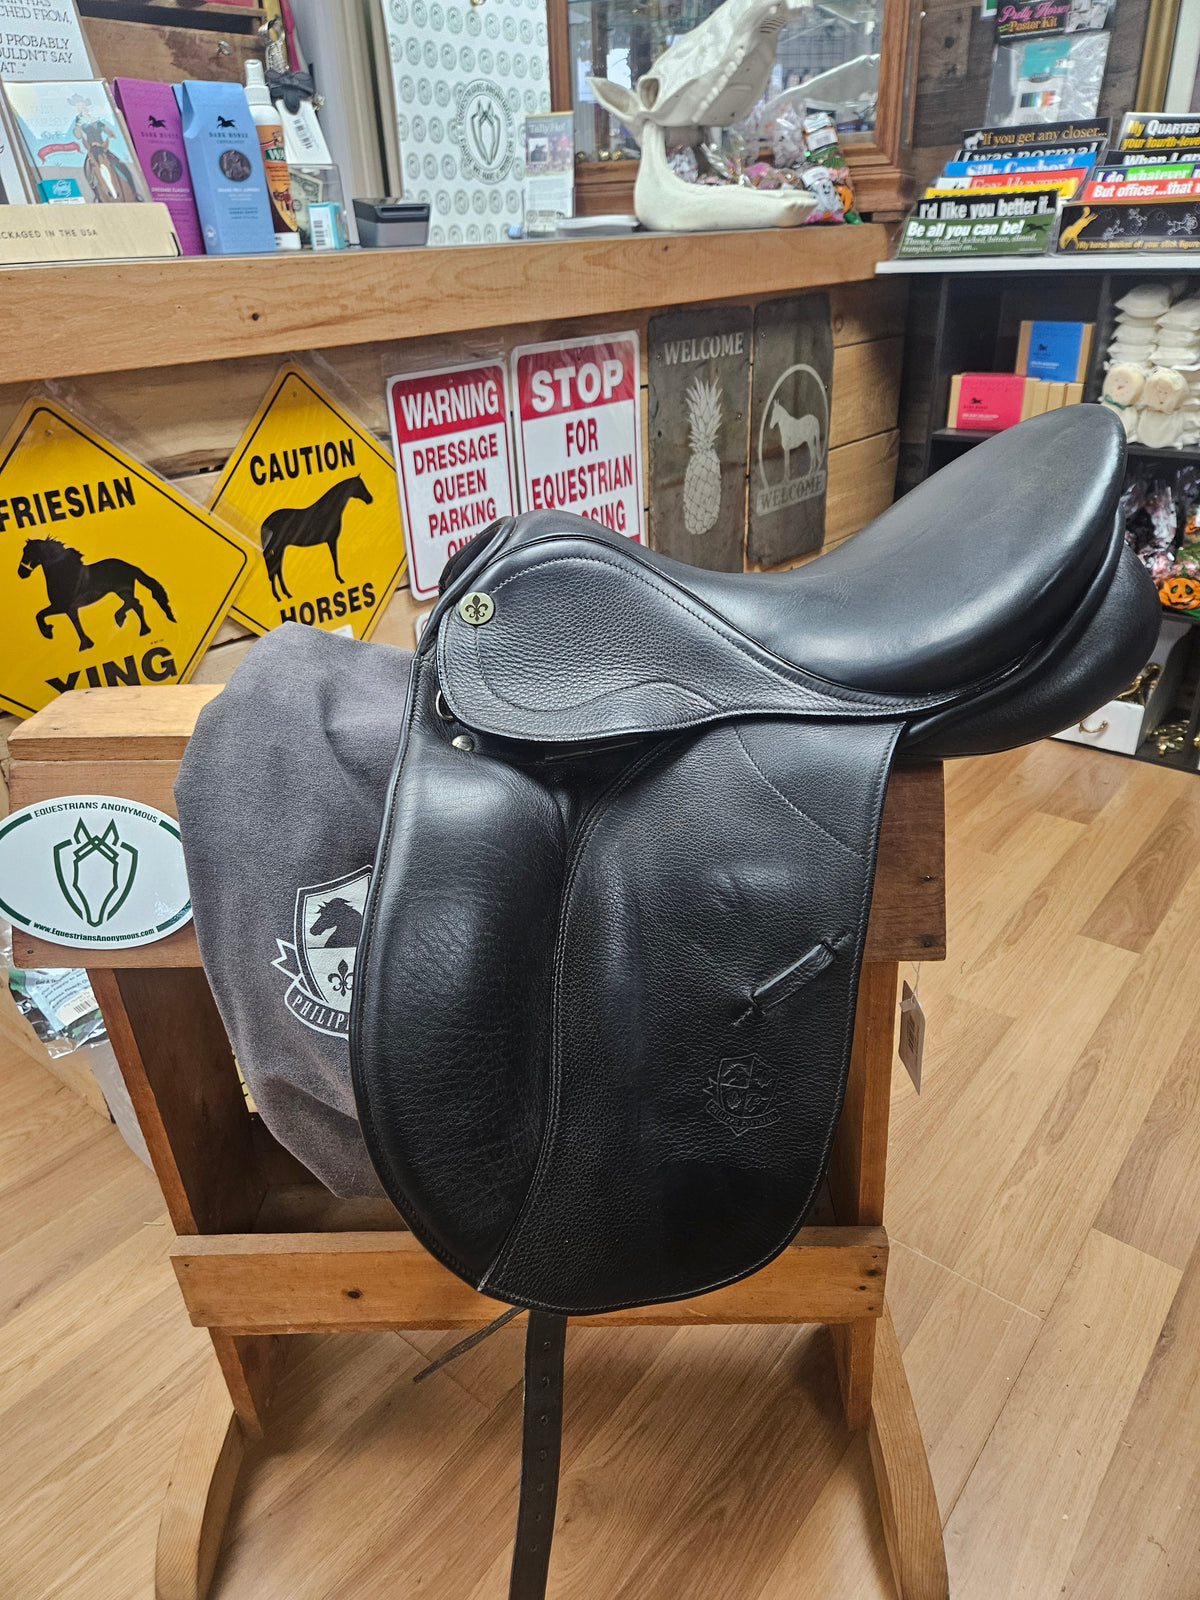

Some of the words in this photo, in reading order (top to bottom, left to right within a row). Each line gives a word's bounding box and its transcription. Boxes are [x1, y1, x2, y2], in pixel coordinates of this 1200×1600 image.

[33, 8, 72, 24] FROM,
[1009, 20, 1041, 32] Poster
[1042, 16, 1058, 28] Kit
[6, 33, 70, 50] PROBABLY
[50, 51, 73, 64] SAY
[982, 133, 994, 146] If
[994, 134, 1016, 147] you
[1016, 131, 1036, 146] get
[1039, 131, 1060, 144] any
[1062, 125, 1108, 140] closer...
[1127, 120, 1145, 137] My
[1122, 137, 1146, 151] your
[1107, 170, 1125, 182] do
[1127, 168, 1190, 180] whatever
[1092, 184, 1116, 198] But
[919, 202, 938, 219] I'd
[939, 201, 968, 219] like
[968, 202, 996, 220] you
[997, 197, 1038, 217] better
[0, 230, 42, 240] CKAGED
[44, 230, 56, 238] IN
[59, 229, 78, 238] THE
[80, 228, 99, 237] USA
[906, 221, 925, 238] Be
[926, 222, 945, 237] all
[946, 223, 972, 240] you
[972, 222, 998, 237] can
[999, 219, 1026, 235] be!
[664, 332, 745, 365] WELCOME
[531, 359, 625, 413] STOP
[400, 380, 499, 432] WARNING
[565, 417, 599, 458] FOR
[250, 439, 356, 486] CAUTION
[413, 433, 499, 476] DRESSAGE
[433, 468, 488, 504] QUEEN
[531, 454, 634, 510] EQUESTRIAN
[760, 474, 823, 509] WELCOME
[0, 477, 136, 532] FRIESIAN
[428, 497, 497, 539] PARKING
[280, 582, 377, 627] HORSES
[34, 801, 99, 818] EQUESTRIANS
[100, 802, 158, 824] ANONYMOUS
[33, 921, 155, 942] www.EquestriansAnonymous.com
